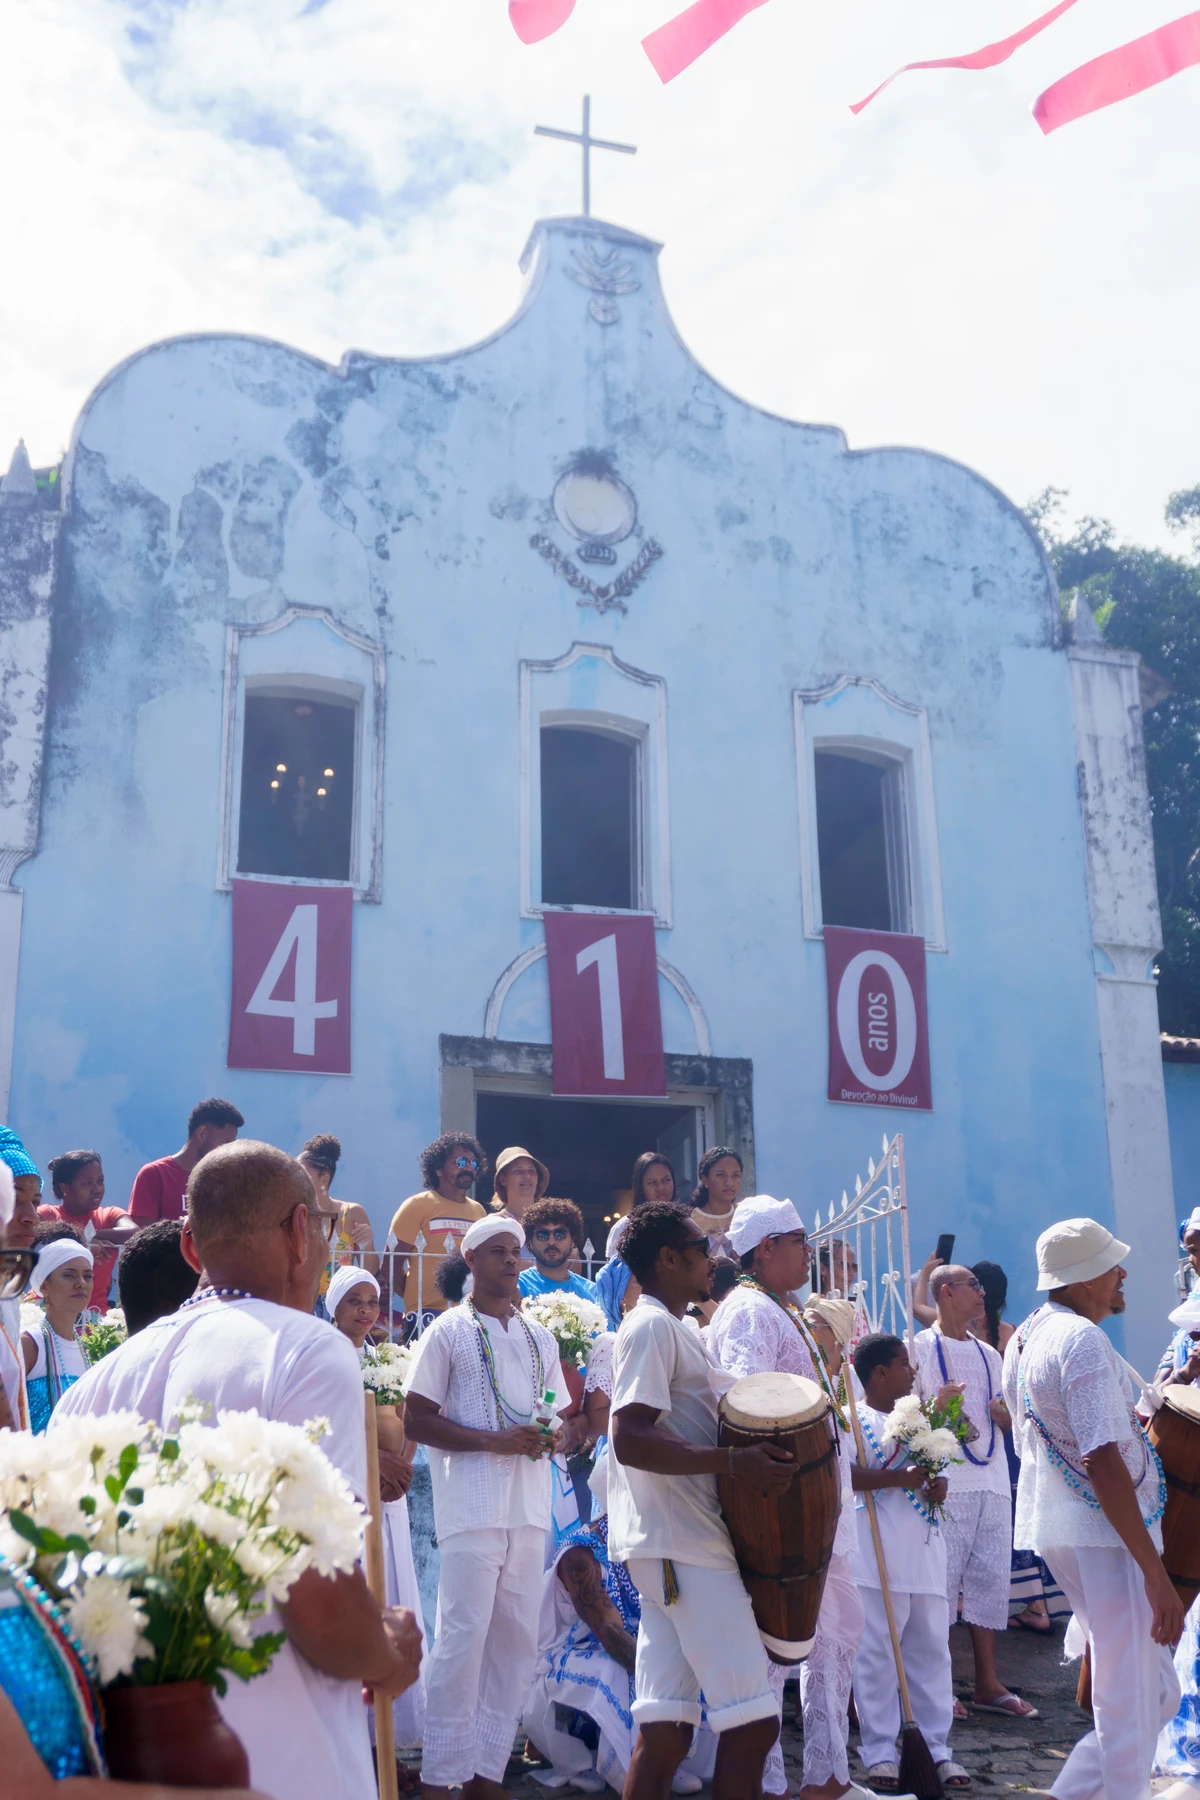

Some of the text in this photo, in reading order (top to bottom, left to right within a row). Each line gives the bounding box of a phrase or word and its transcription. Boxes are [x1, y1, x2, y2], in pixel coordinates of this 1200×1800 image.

[245, 904, 338, 1056] 4
[576, 934, 625, 1080] 1
[837, 949, 917, 1091] 0
[868, 992, 888, 1051] anos
[841, 1088, 918, 1105] Devoção ao Divino!
